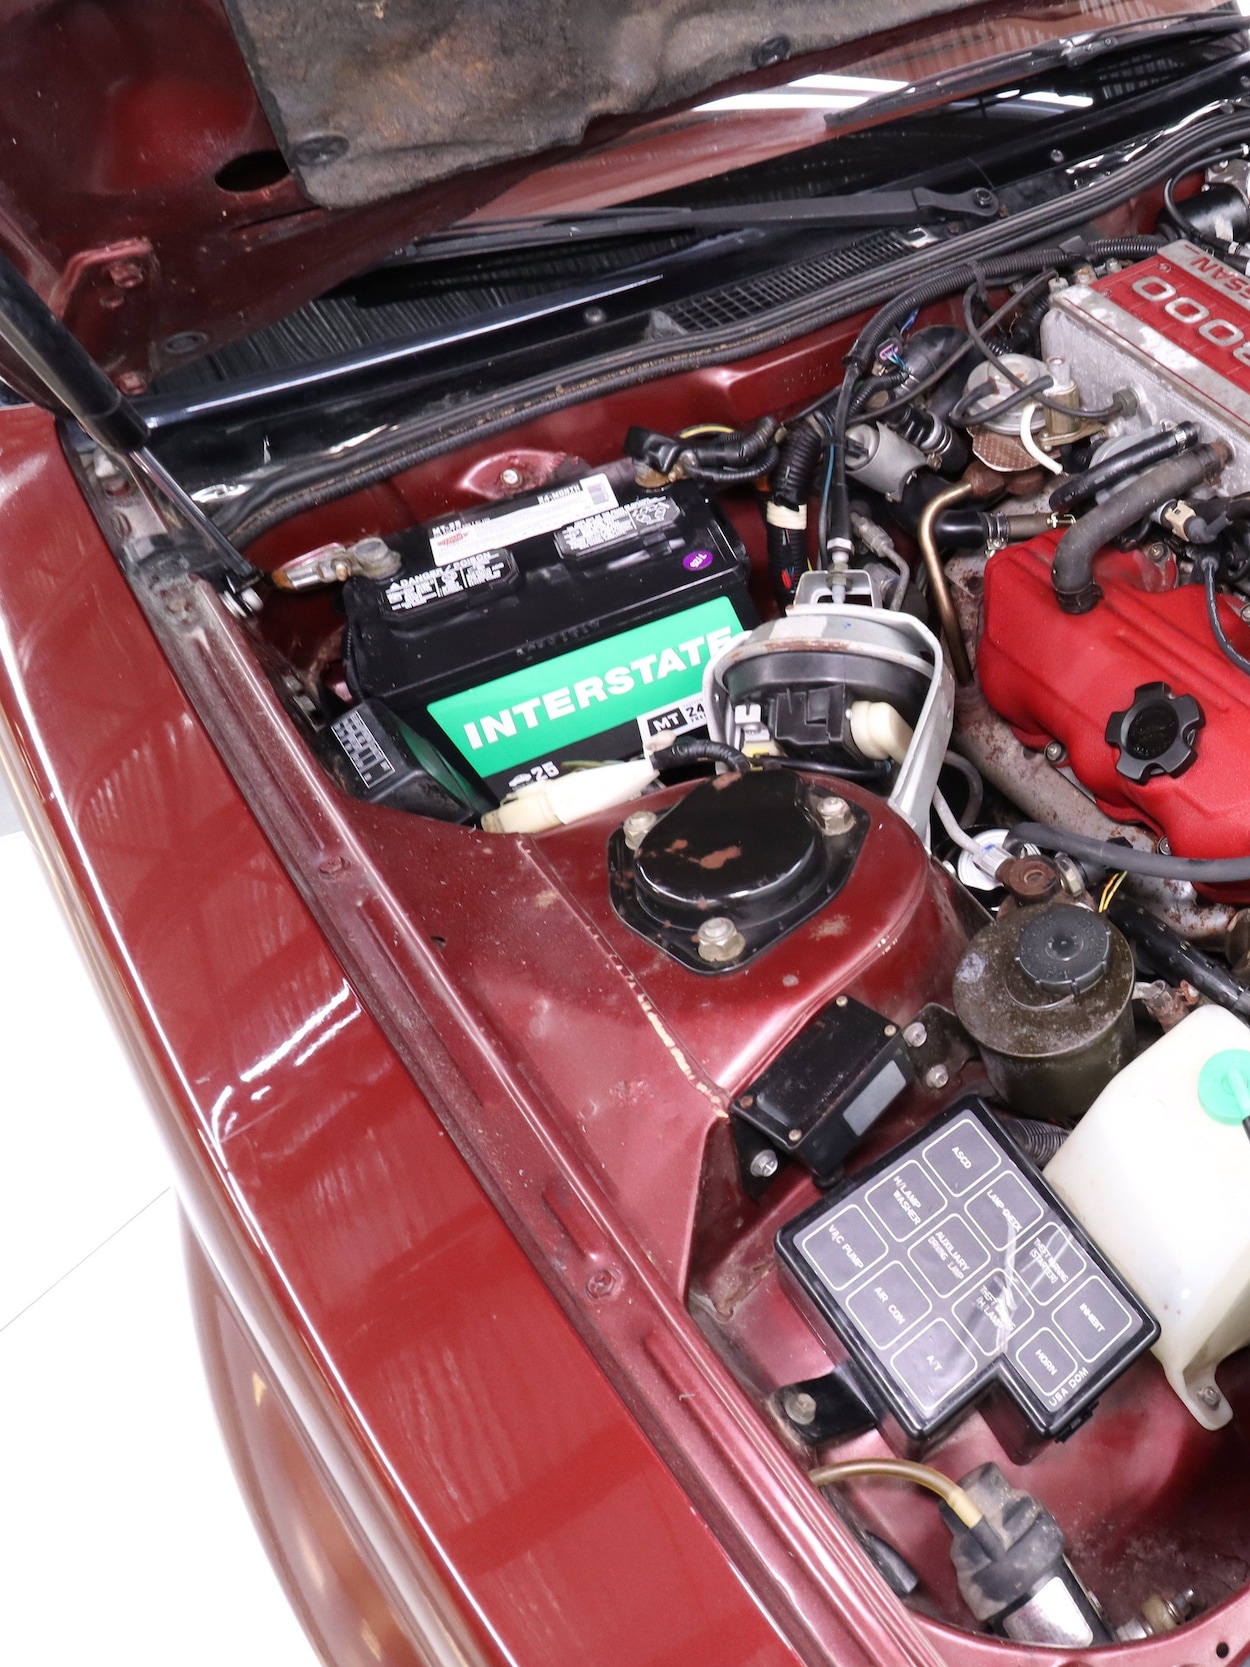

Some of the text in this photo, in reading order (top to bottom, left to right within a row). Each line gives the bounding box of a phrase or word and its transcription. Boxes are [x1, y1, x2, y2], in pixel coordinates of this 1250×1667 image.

[400, 568, 444, 586] DANGER
[464, 626, 732, 750] INTERSTATE
[652, 712, 680, 732] MT
[952, 1146, 972, 1169] ASCD
[893, 1190, 921, 1225] WASHER
[894, 1176, 921, 1208] H/LAMP
[987, 1190, 1022, 1232] LAMP CHECK
[829, 1224, 864, 1268] VAC PUMP
[935, 1231, 970, 1272] AUXILIARY
[948, 1262, 965, 1280] LAMP
[874, 1287, 906, 1324] AIR CON
[1080, 1303, 1106, 1333] INHIBIT
[926, 1354, 942, 1372] A/T
[1035, 1348, 1058, 1376] HORN
[1049, 1367, 1089, 1407] USA DOM
